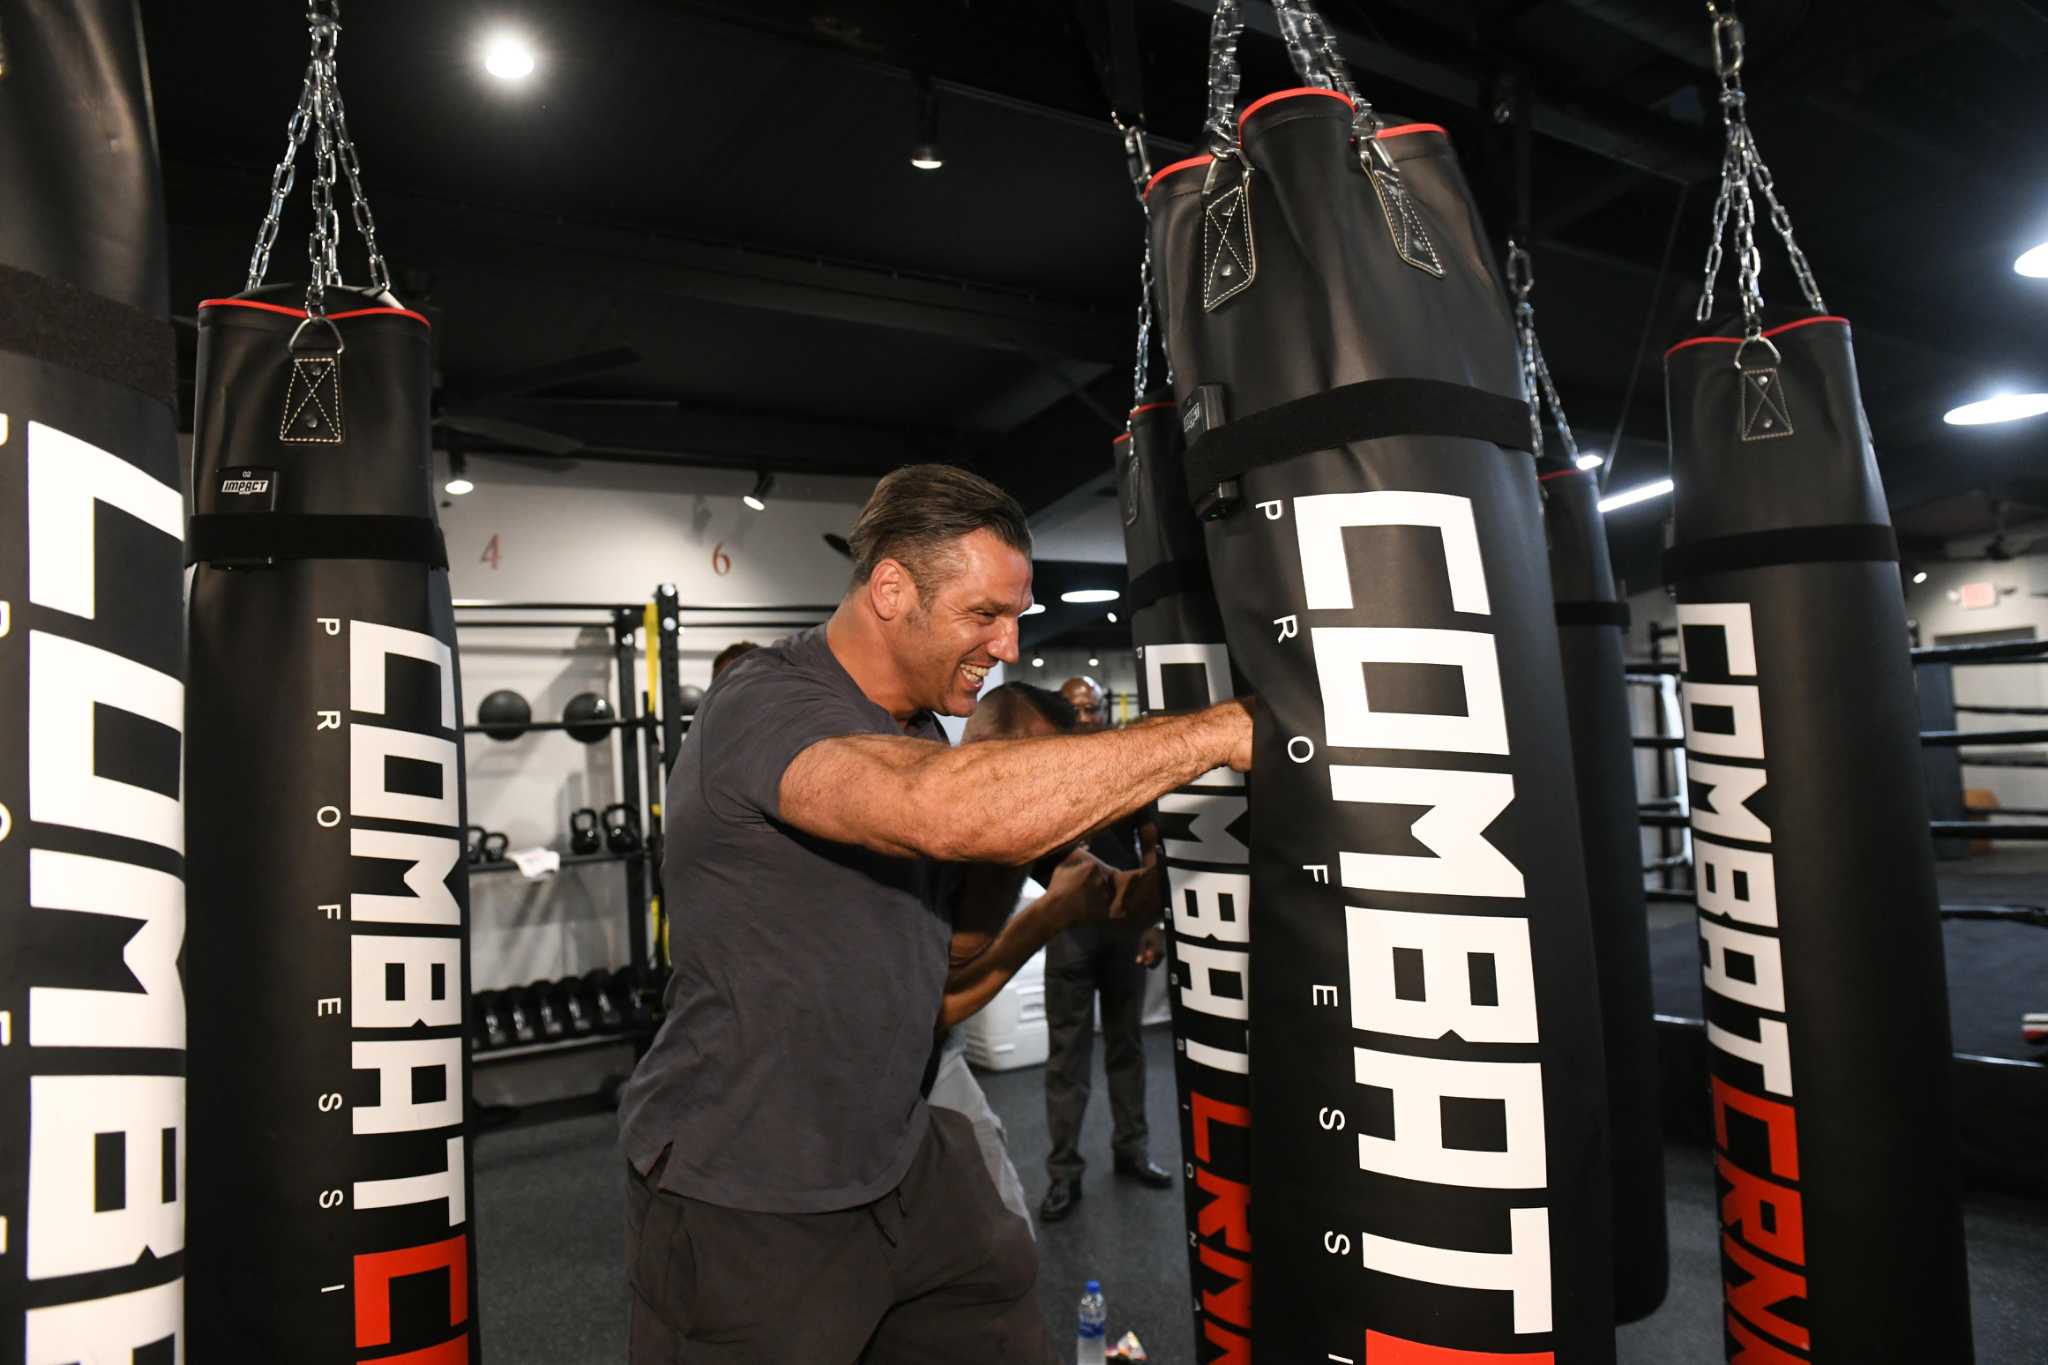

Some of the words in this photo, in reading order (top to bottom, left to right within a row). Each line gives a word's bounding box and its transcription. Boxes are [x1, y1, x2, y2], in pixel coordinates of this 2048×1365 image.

[223, 480, 268, 492] IMPACT
[480, 533, 503, 570] 4
[711, 541, 731, 577] 6
